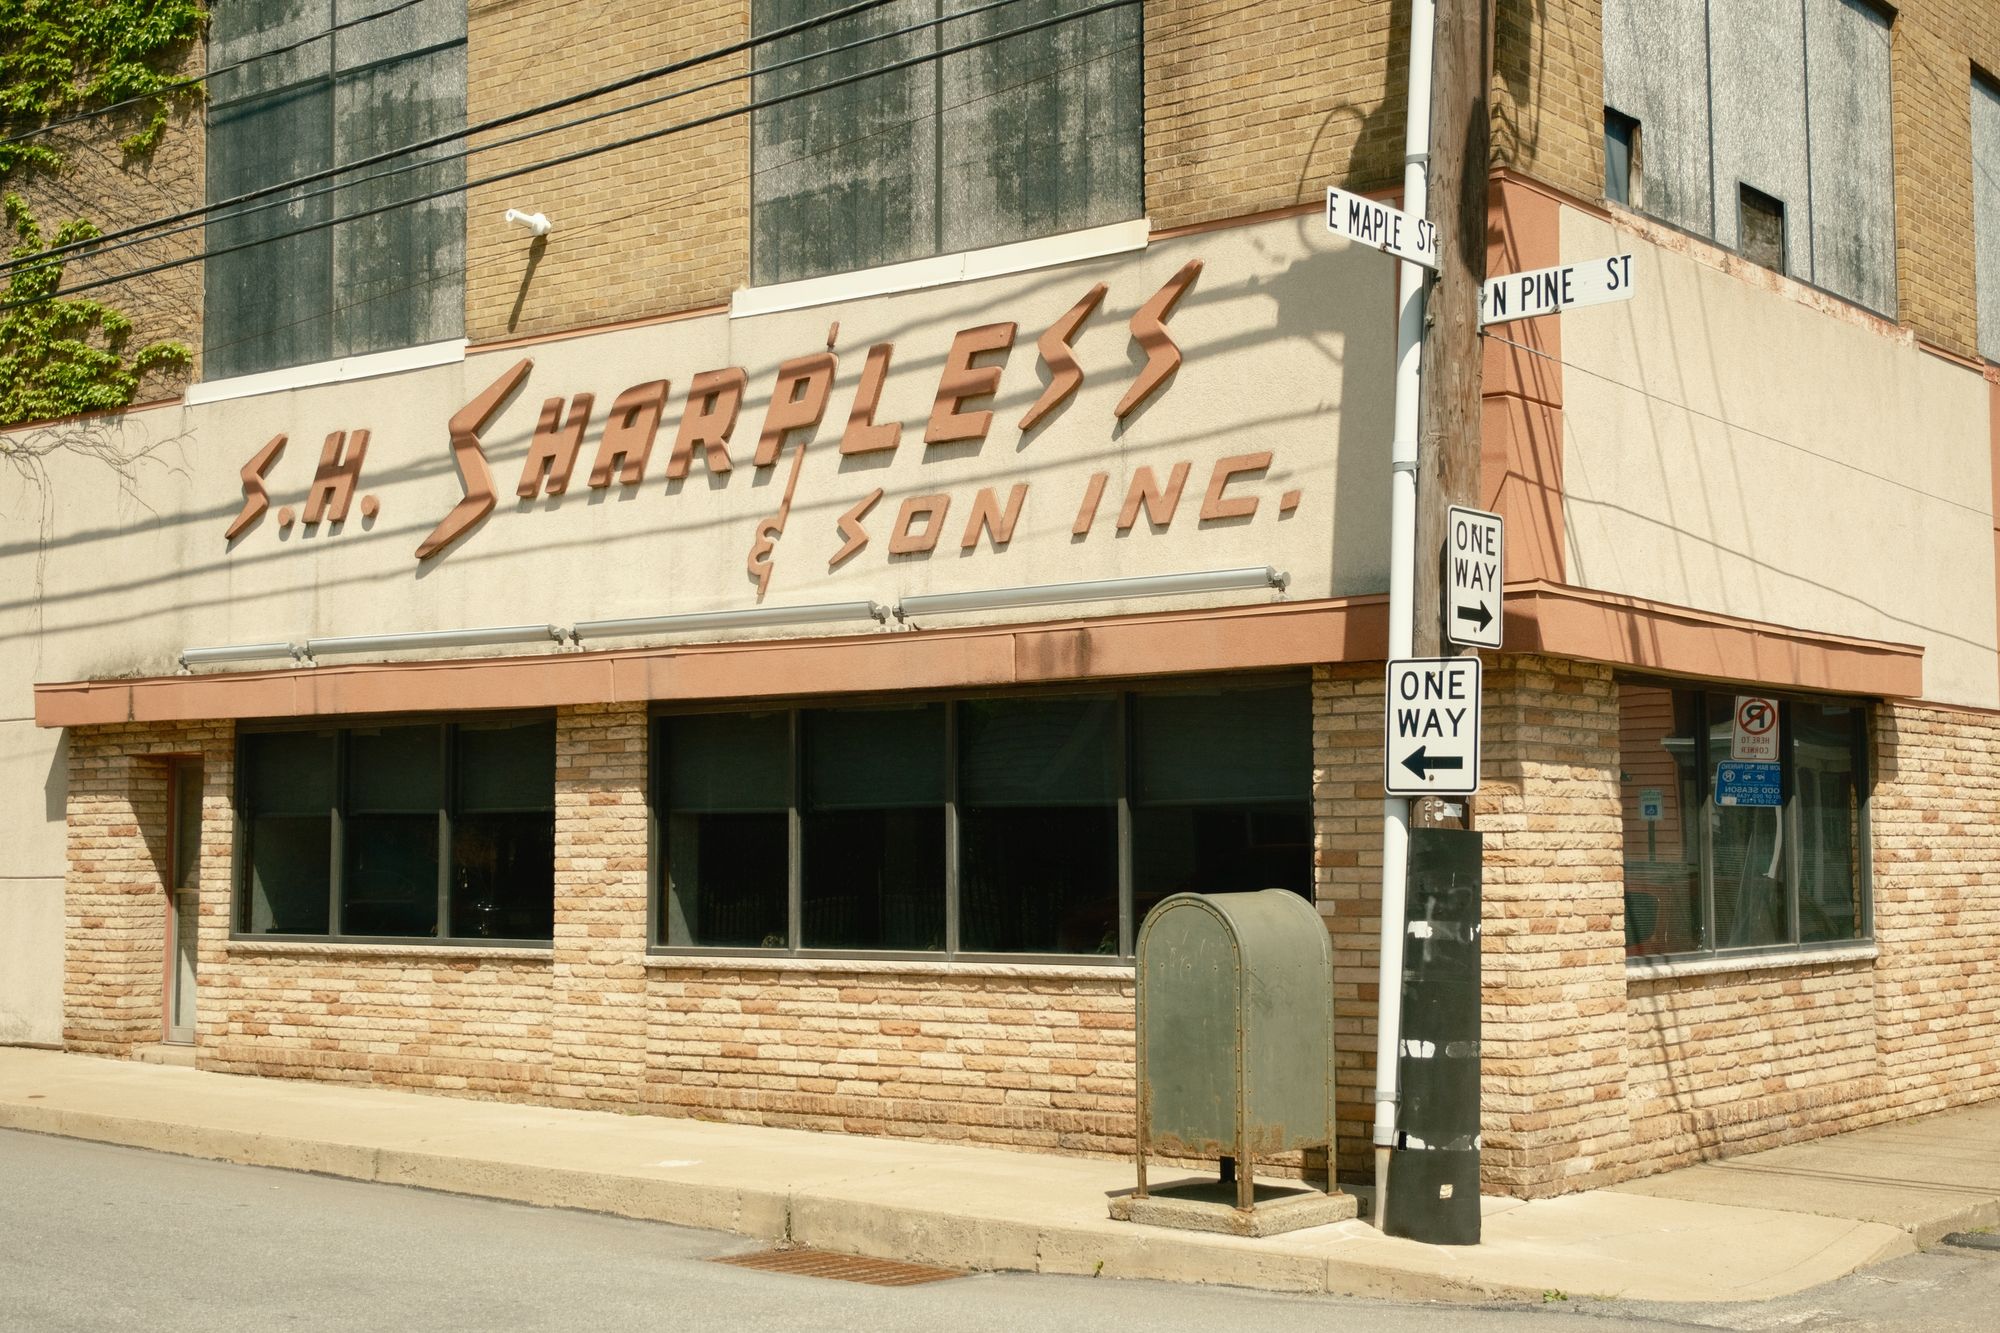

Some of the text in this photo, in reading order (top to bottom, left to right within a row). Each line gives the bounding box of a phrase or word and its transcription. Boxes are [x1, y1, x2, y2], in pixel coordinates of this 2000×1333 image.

[1329, 192, 1434, 253] E MAPLE ST
[1493, 254, 1632, 317] N PINE ST
[414, 258, 1204, 561] SHARPLESS
[828, 483, 1029, 567] SON
[1072, 451, 1300, 536] INC.
[1456, 520, 1496, 557] ONE
[1455, 557, 1497, 593] WAY
[1400, 670, 1466, 701] ONE
[1398, 708, 1467, 738] WAY
